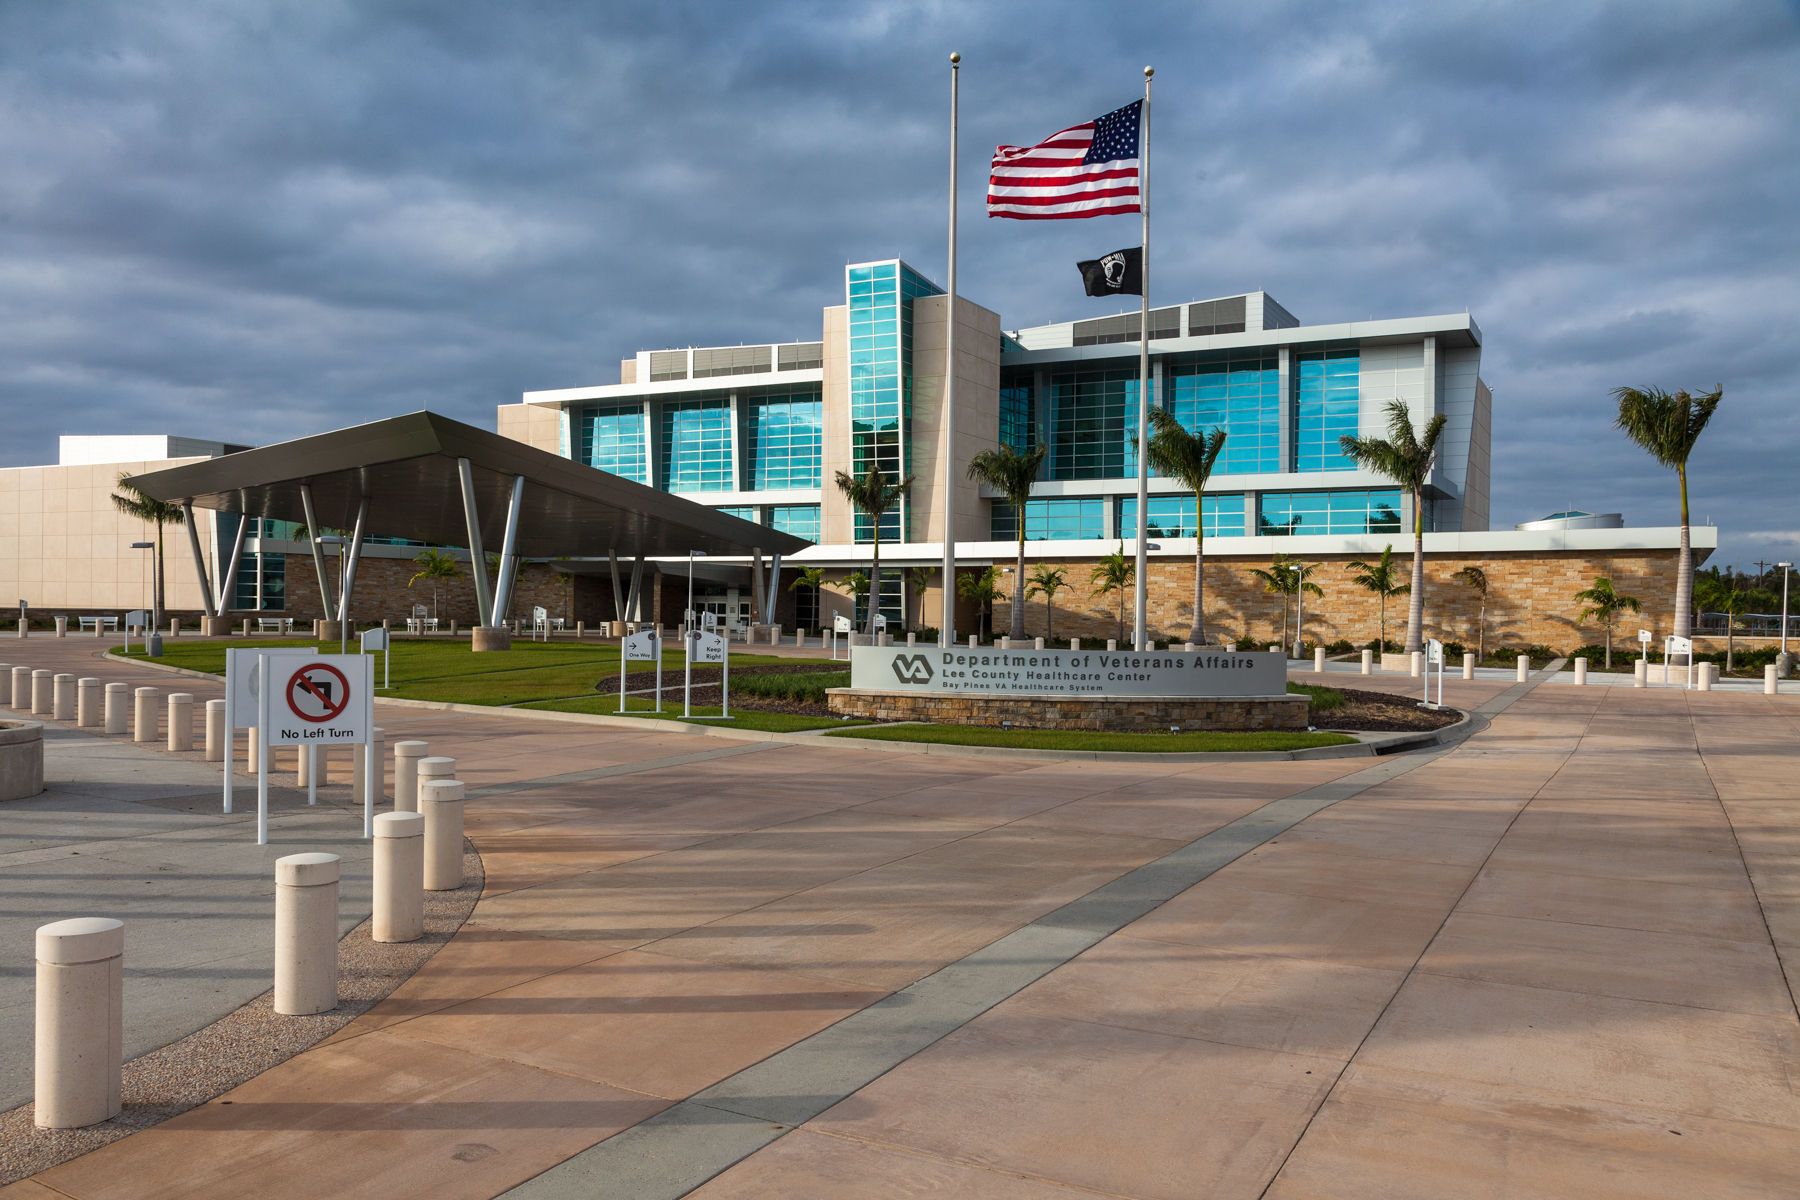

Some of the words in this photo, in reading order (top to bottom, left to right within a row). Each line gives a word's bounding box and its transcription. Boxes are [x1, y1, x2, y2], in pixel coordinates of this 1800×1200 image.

[706, 646, 721, 654] Keep
[942, 652, 1060, 668] Department
[1071, 655, 1090, 668] of
[1100, 655, 1185, 669] Veterans
[1194, 656, 1254, 669] Affairs
[893, 656, 933, 682] VA
[942, 669, 966, 678] Lee
[971, 670, 1020, 681] County
[1027, 670, 1101, 681] Healthcare
[1107, 672, 1152, 681] Center
[281, 729, 300, 739] No
[303, 728, 325, 738] Left
[328, 728, 354, 738] Turn
